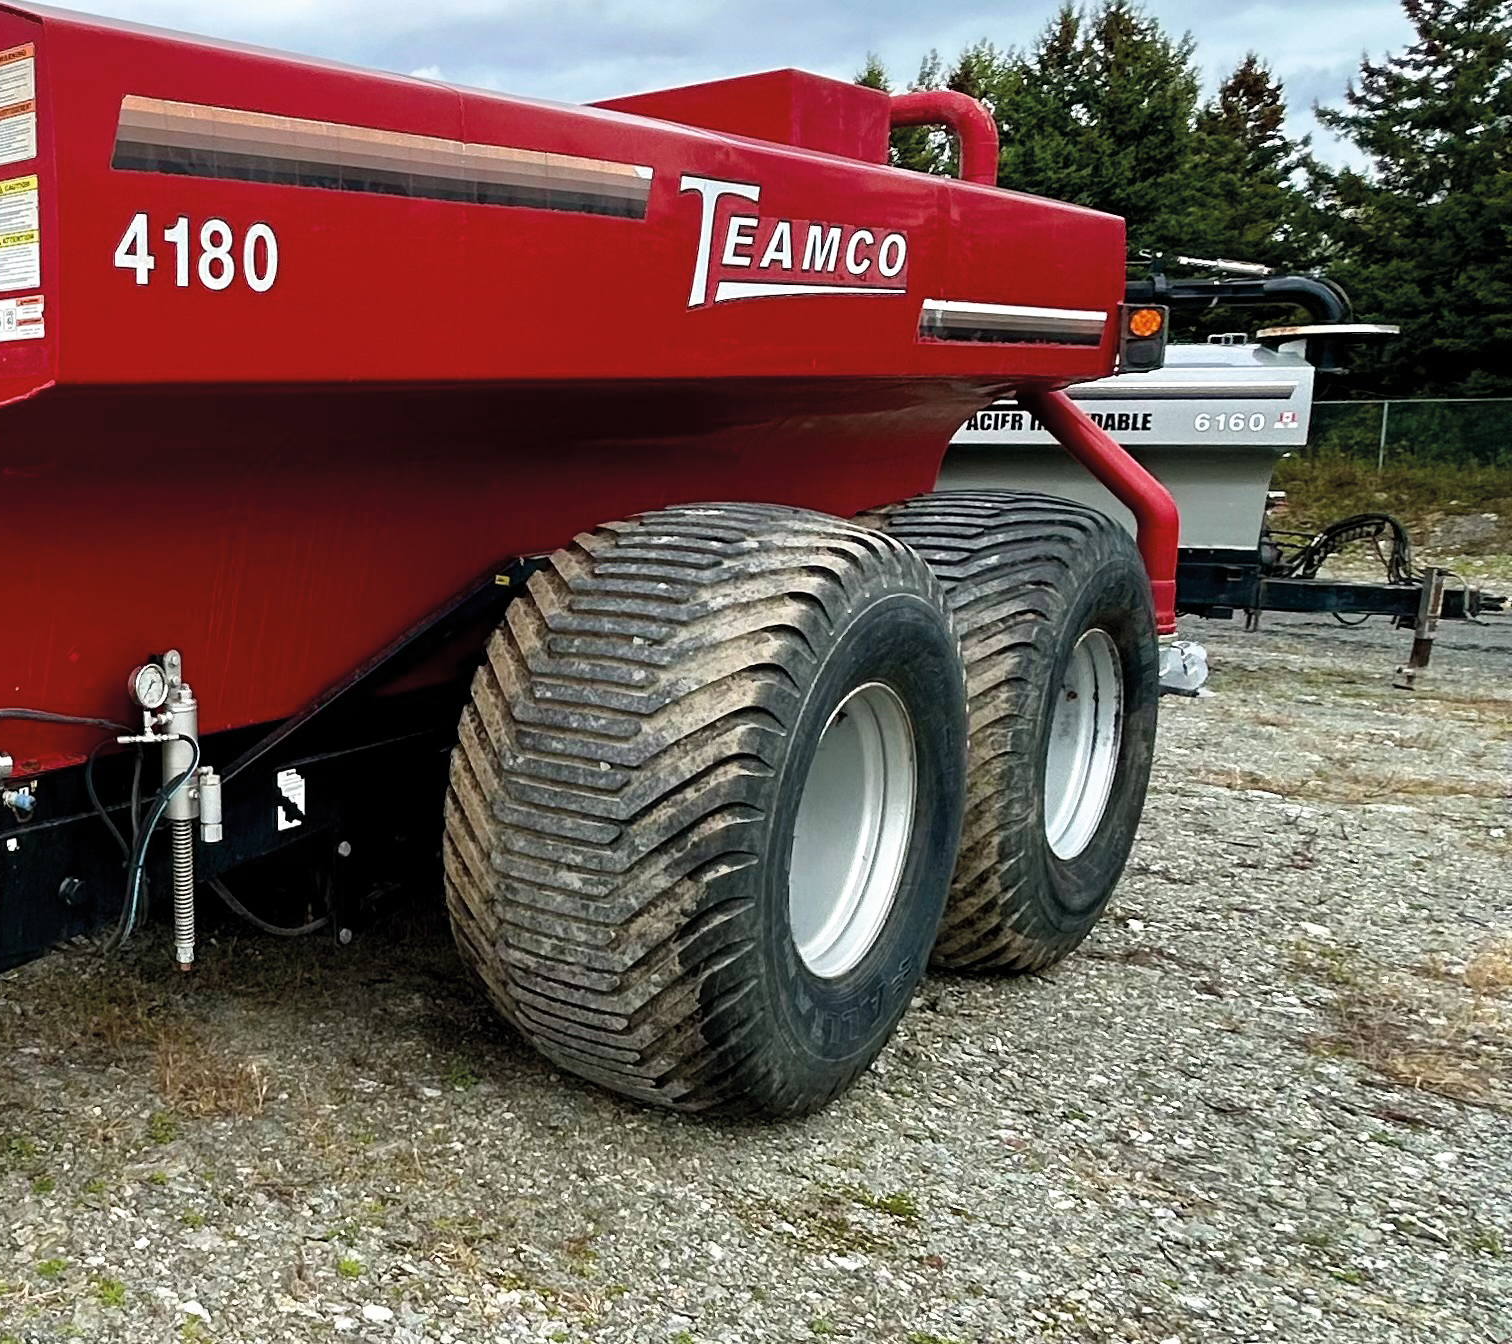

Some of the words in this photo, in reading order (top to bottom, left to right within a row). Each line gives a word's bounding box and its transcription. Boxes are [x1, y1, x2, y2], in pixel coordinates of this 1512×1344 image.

[114, 212, 279, 293] 4180
[679, 175, 908, 307] TEAMCO
[1194, 413, 1265, 431] 6160
